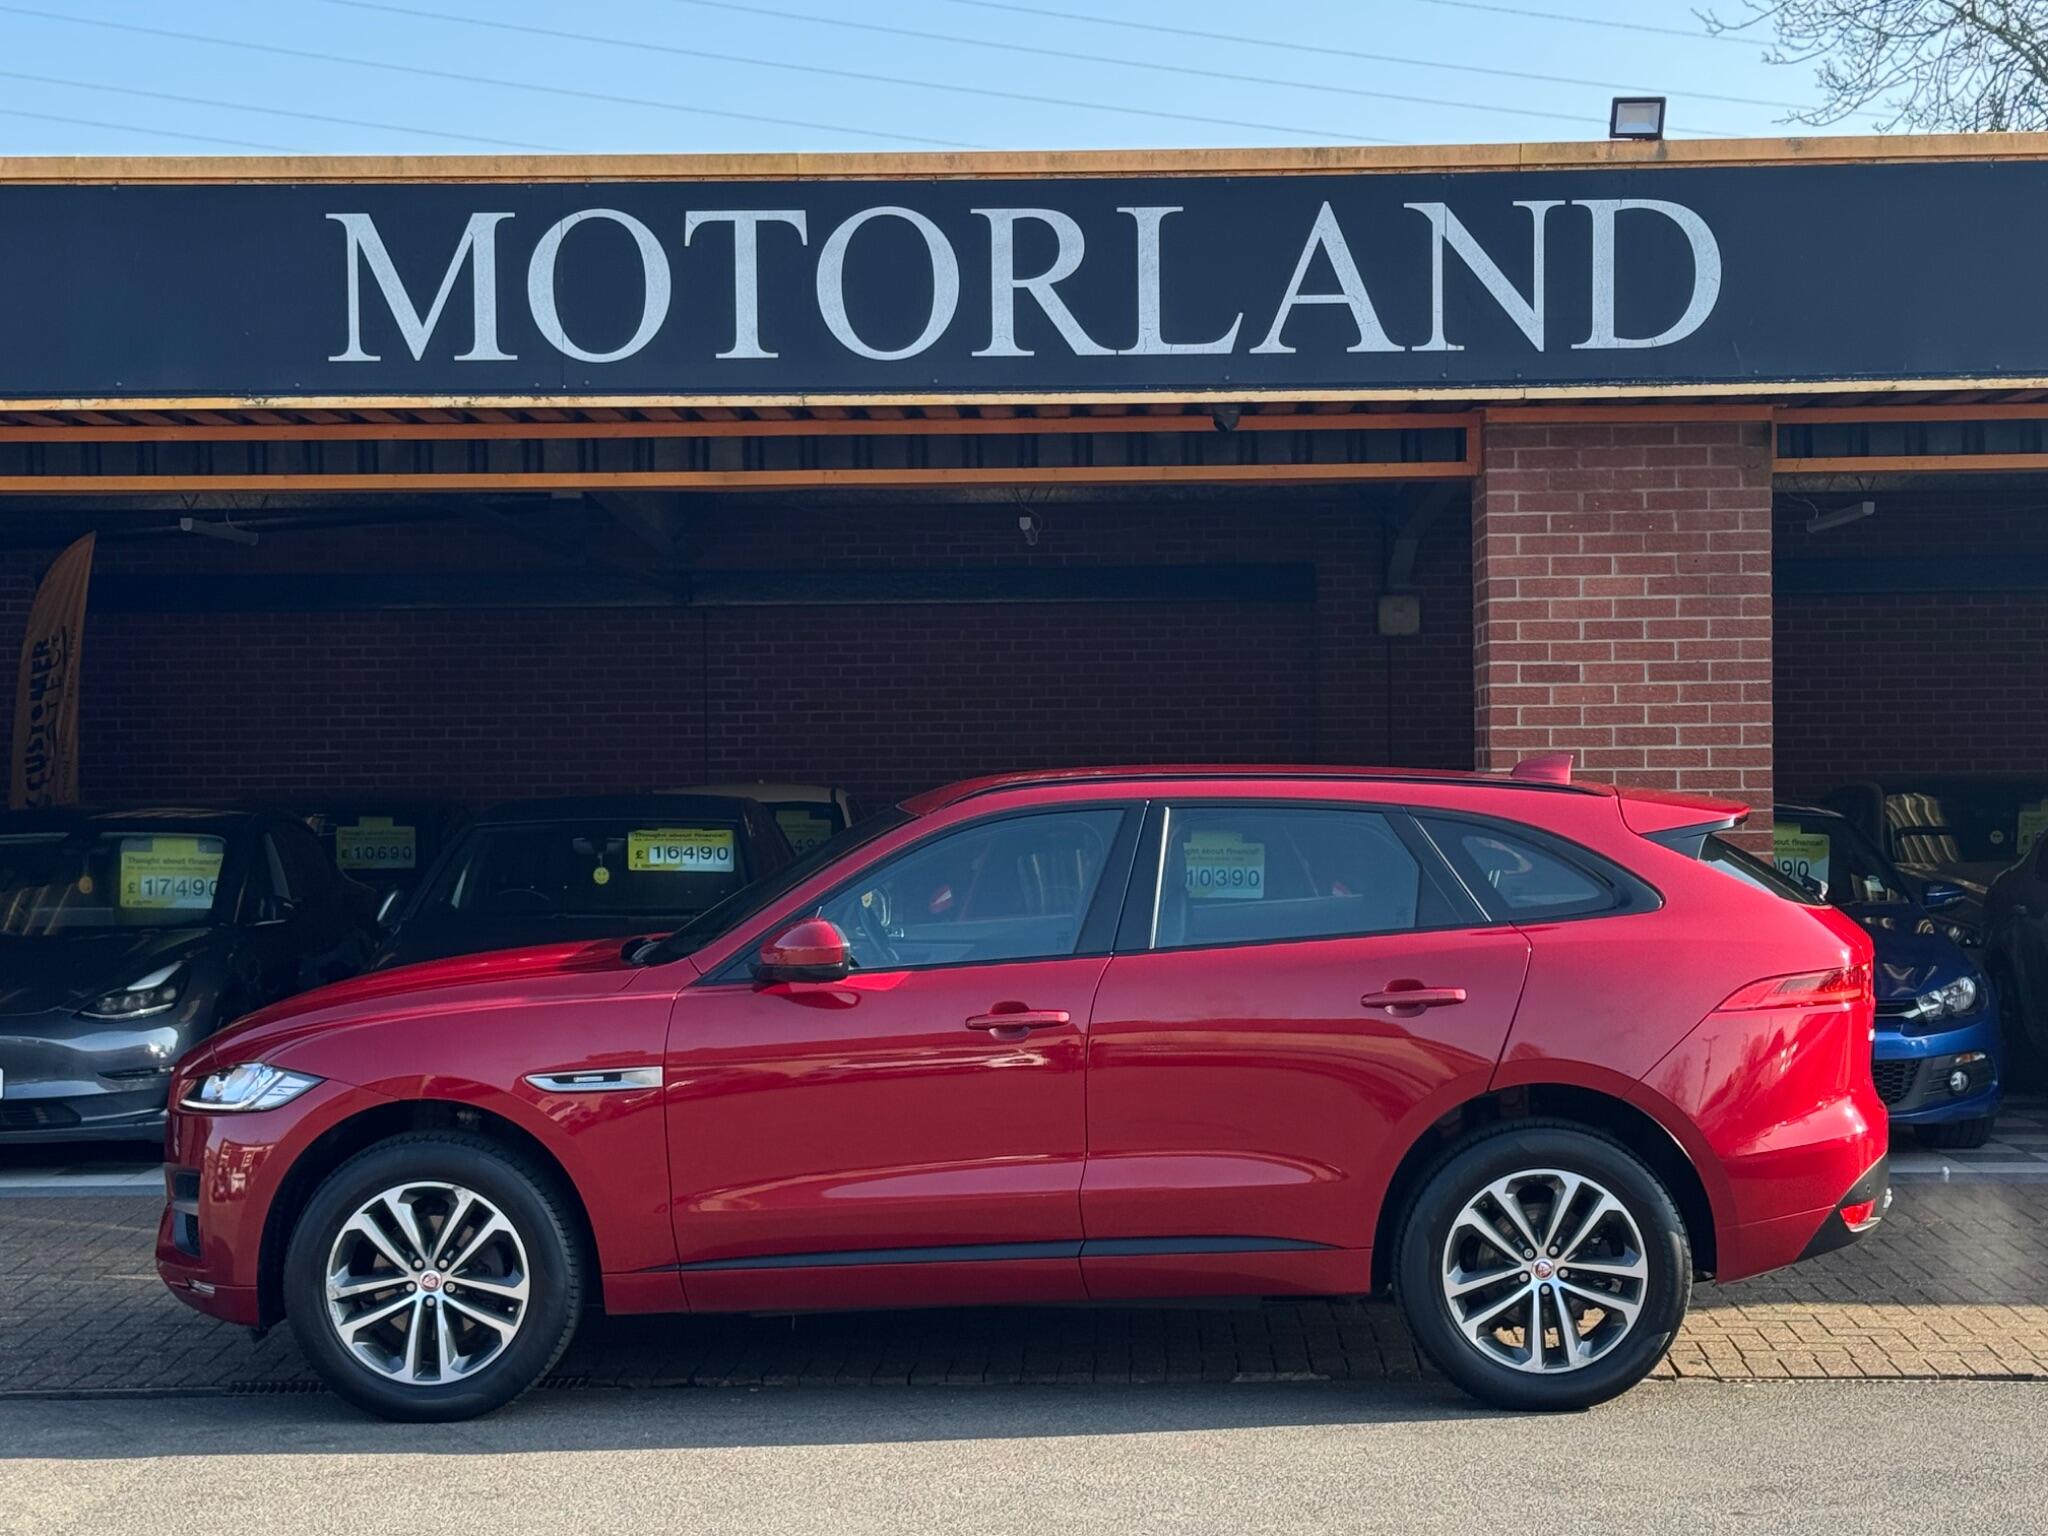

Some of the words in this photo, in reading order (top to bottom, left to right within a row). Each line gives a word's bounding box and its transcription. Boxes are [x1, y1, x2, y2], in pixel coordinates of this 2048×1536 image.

[326, 198, 1722, 362] MOTORLAND
[354, 845, 412, 860] 10690
[652, 846, 729, 861] 16490
[1185, 868, 1260, 887] 10390
